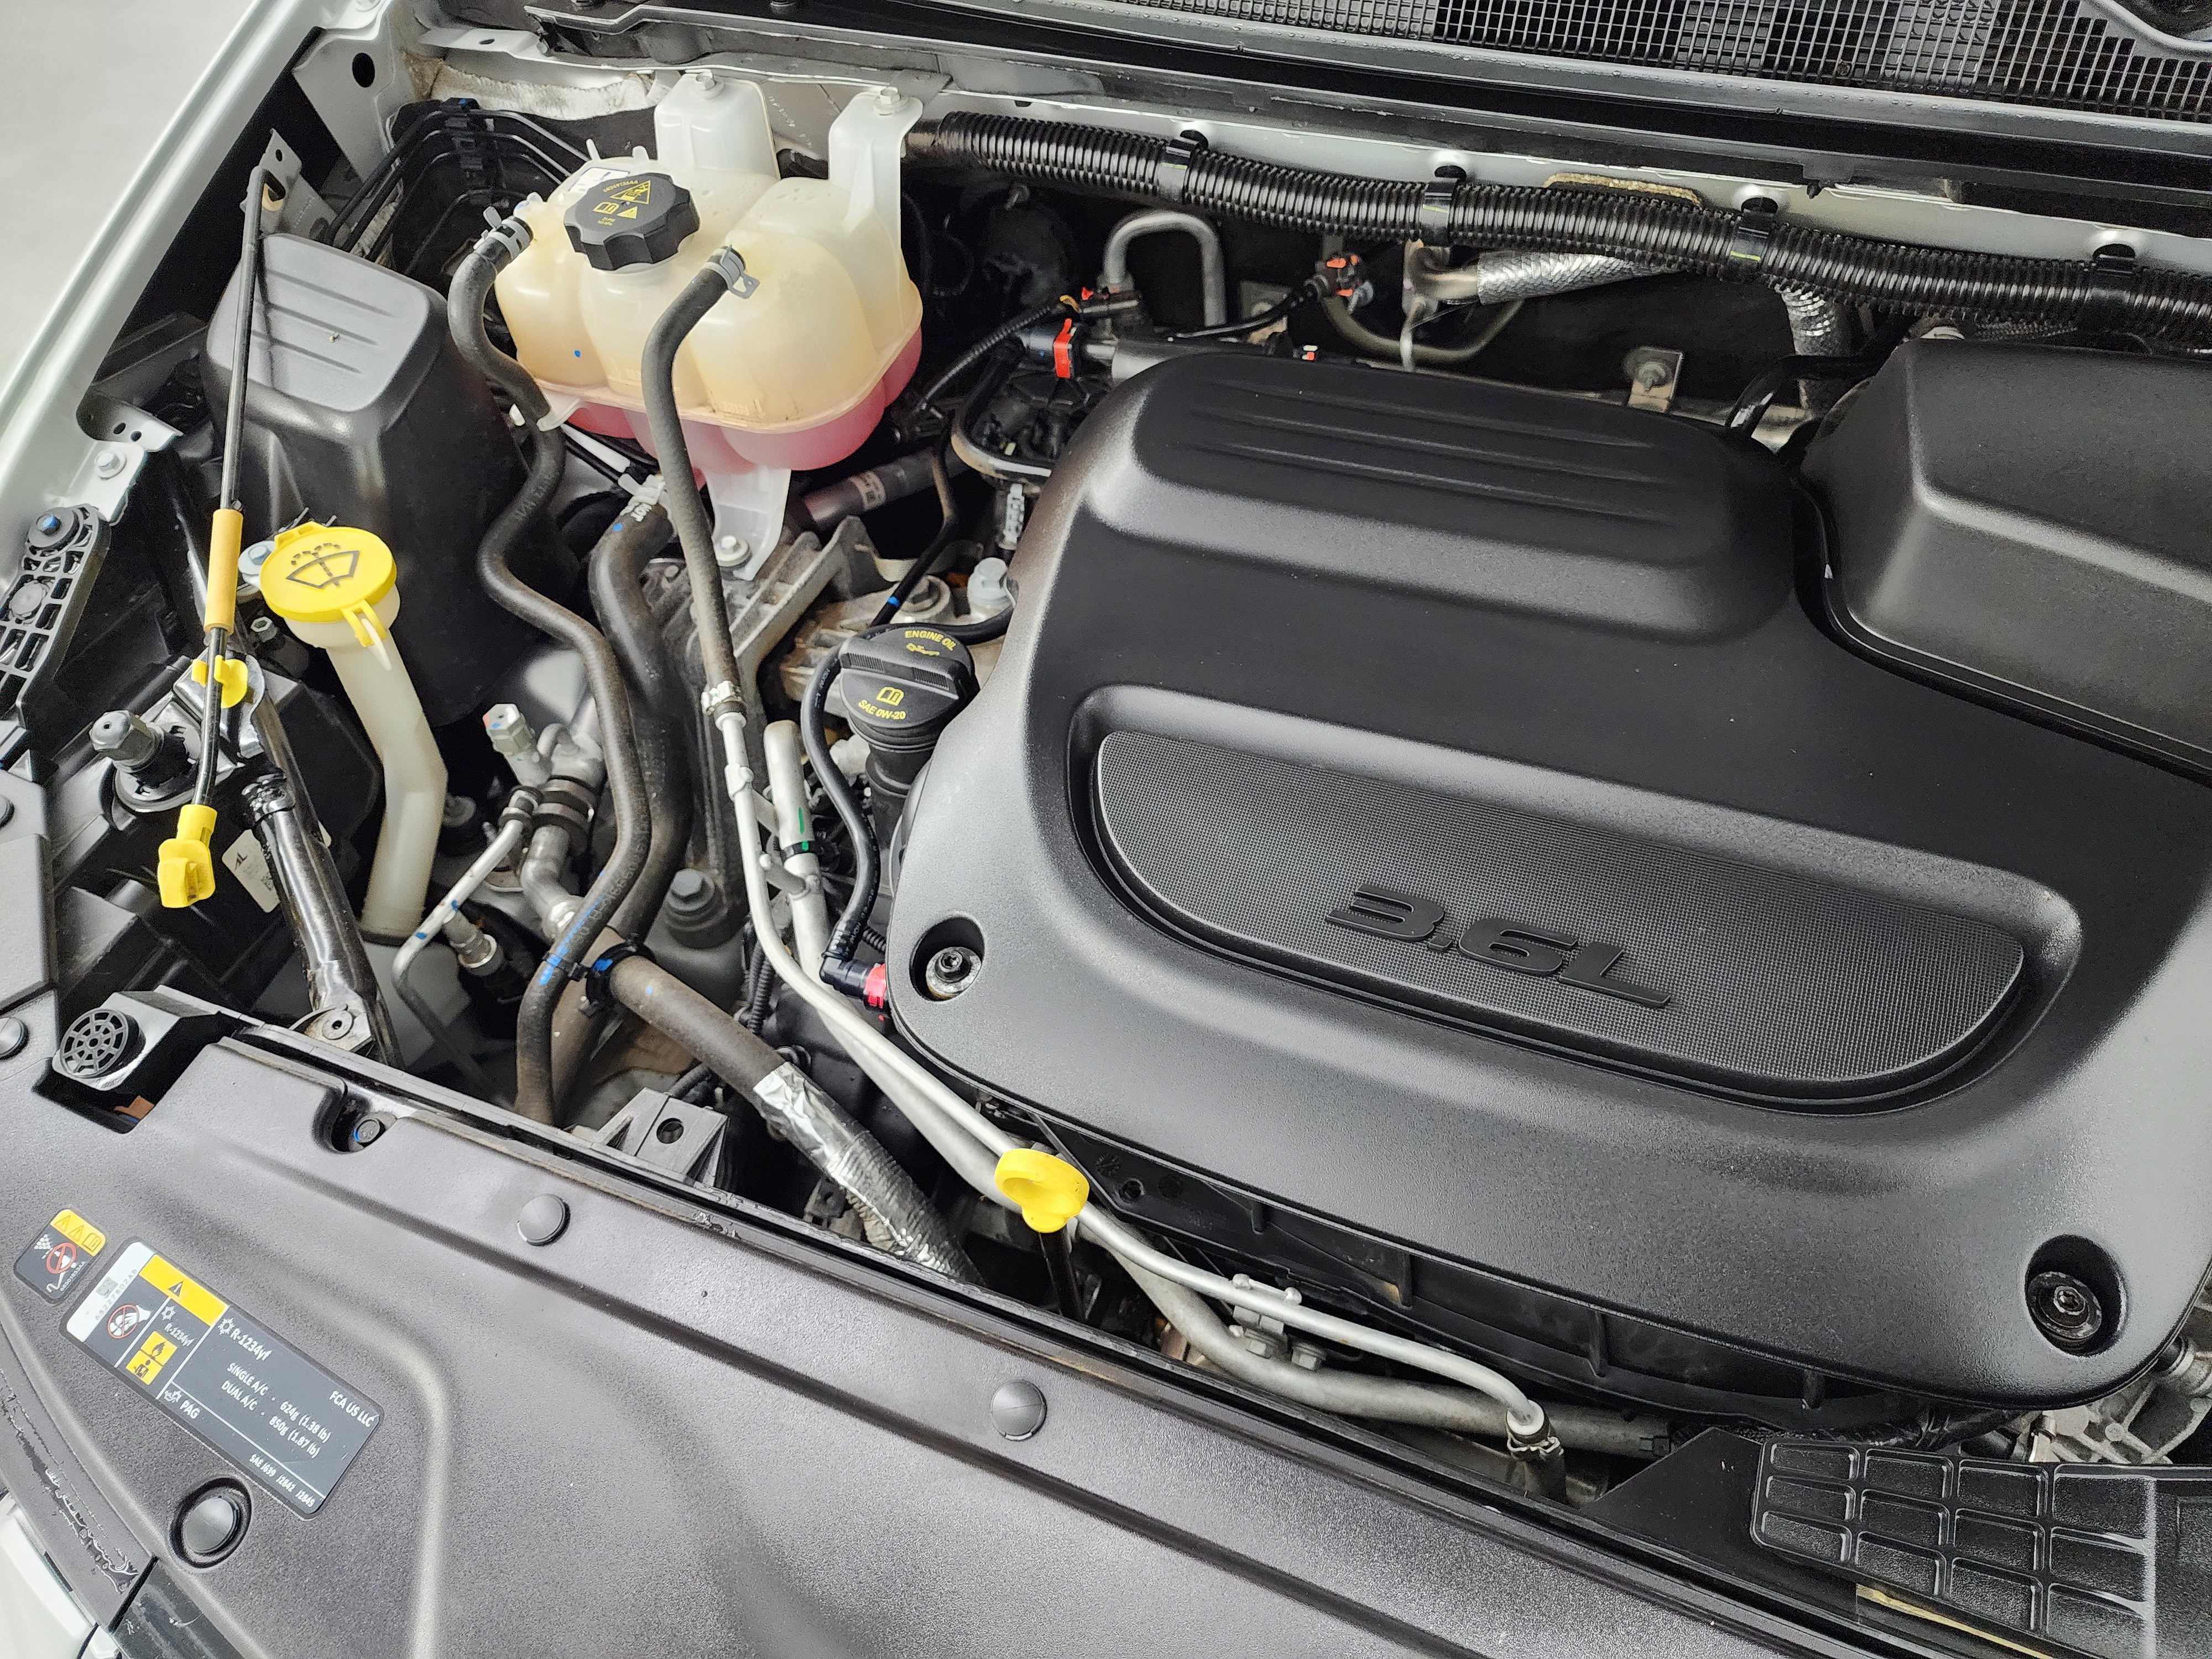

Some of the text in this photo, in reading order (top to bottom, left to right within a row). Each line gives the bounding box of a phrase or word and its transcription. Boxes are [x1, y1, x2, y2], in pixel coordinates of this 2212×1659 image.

[905, 630, 956, 651] ENGINE OIL
[858, 699, 906, 719] SAE 0W-20
[1327, 885, 1671, 1010] 3.6L
[165, 1323, 195, 1347] R-1234yf
[230, 1328, 272, 1361] R-1234yf
[227, 1362, 269, 1396] SINGLE A/C
[179, 1400, 200, 1419] PAG
[221, 1380, 258, 1411] DUAL A/C
[329, 1390, 375, 1427] FCA US LLC
[269, 1416, 290, 1436] 850g
[287, 1428, 311, 1448] (1.87
[280, 1401, 300, 1421] 624g
[298, 1413, 322, 1434] (1.38
[249, 1454, 316, 1507] SAE J639 J2842 J2845
